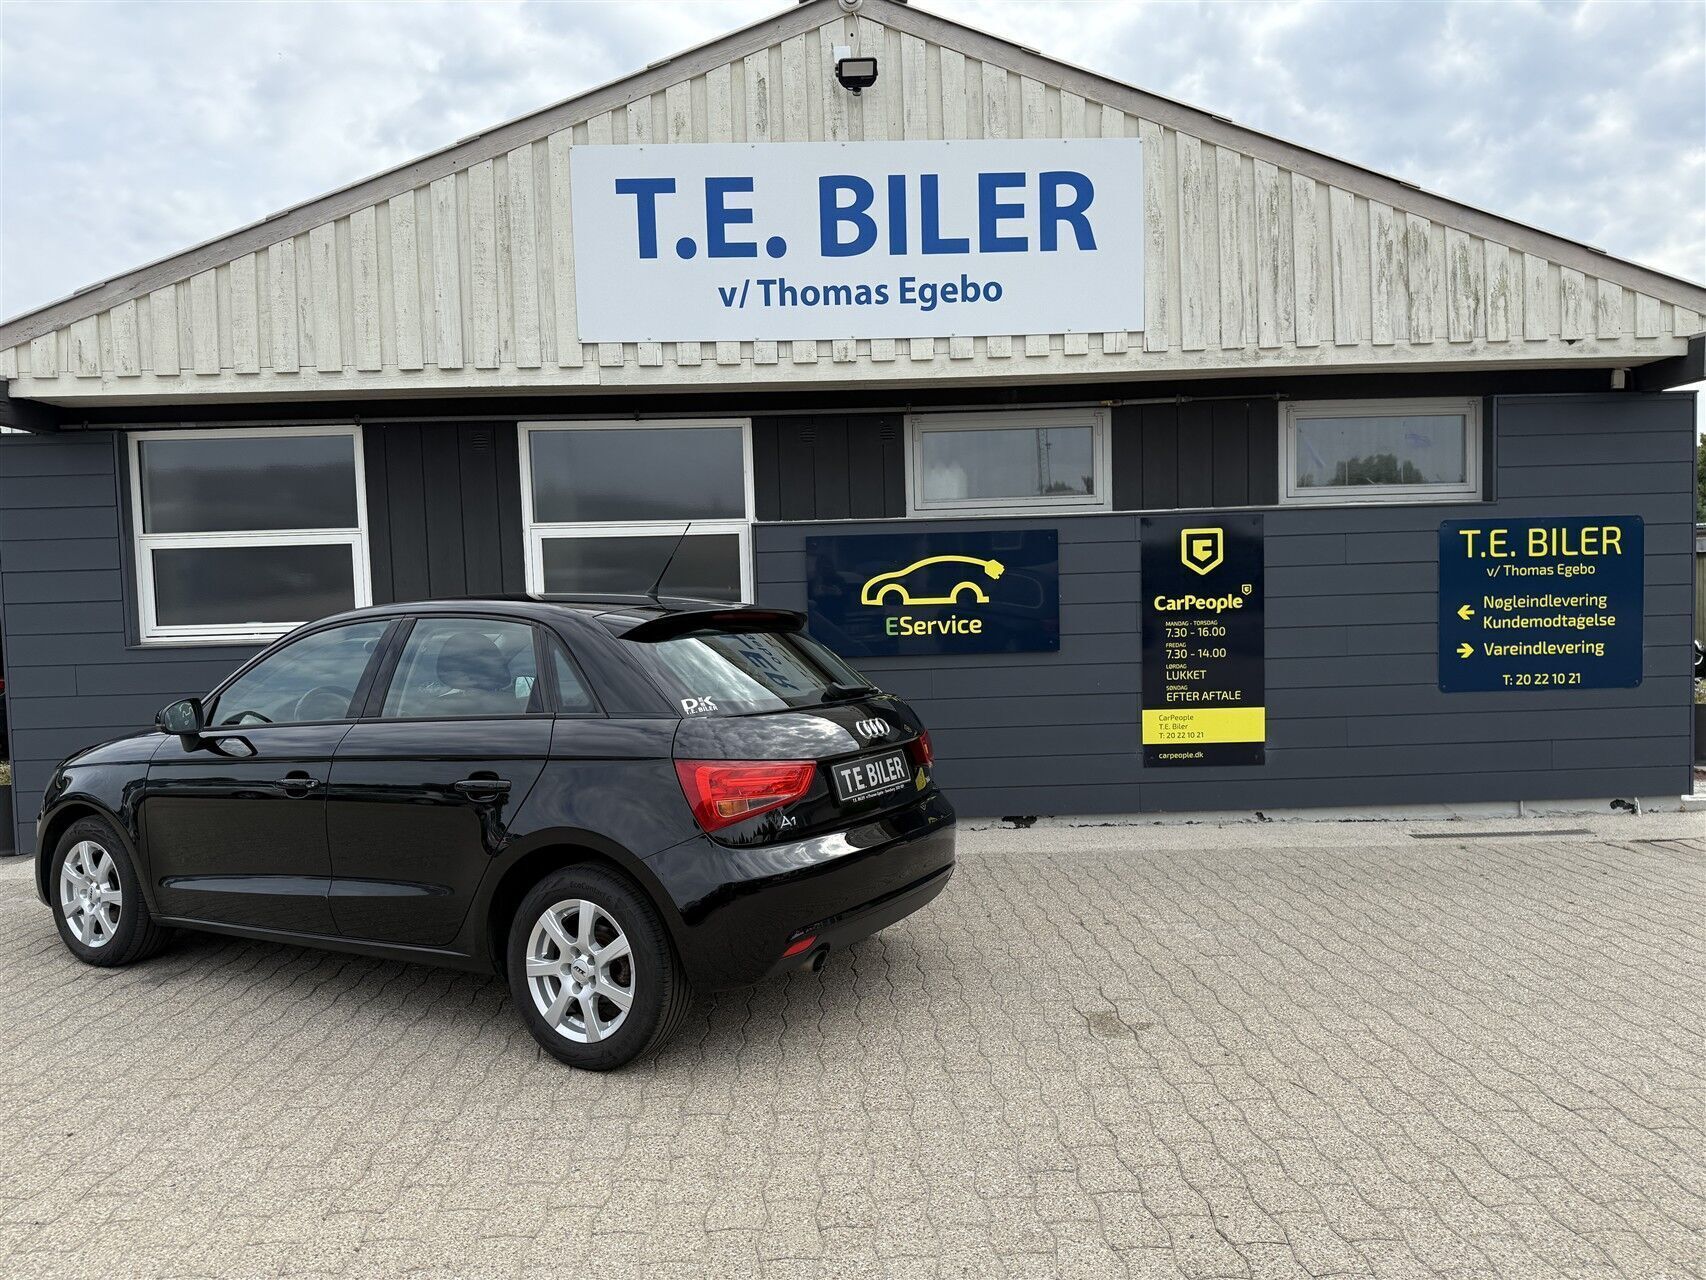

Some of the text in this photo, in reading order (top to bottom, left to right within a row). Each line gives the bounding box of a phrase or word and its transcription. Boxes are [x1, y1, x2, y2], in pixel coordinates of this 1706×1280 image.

[615, 170, 1098, 260] T.E. BILER
[718, 274, 1003, 311] v/ Thomas Egebo
[1459, 526, 1622, 558] T.E. BILER
[1487, 563, 1596, 578] v/ Thomas Egebo
[1154, 593, 1243, 614] CarPeople
[1483, 593, 1608, 611] Nøgleindlevering
[885, 615, 983, 636] EService
[1483, 613, 1616, 630] Kundemodtagelse
[1165, 628, 1188, 638] 7.30
[1198, 626, 1226, 637] 16.00
[1166, 649, 1188, 659] 7.30
[1198, 648, 1227, 658] 14.00
[1484, 640, 1605, 657] Vareindlevering
[1166, 670, 1207, 680] LUKKET
[1503, 672, 1581, 686] T: 20 22 10 21
[1166, 690, 1241, 702] EFTER AFTALE
[1158, 714, 1194, 722] CarPeople
[1172, 722, 1189, 730] Biler
[1187, 731, 1195, 739] 10
[1158, 751, 1204, 760] carpeople.dk
[865, 756, 906, 787] BILER
[780, 815, 797, 829] A1
